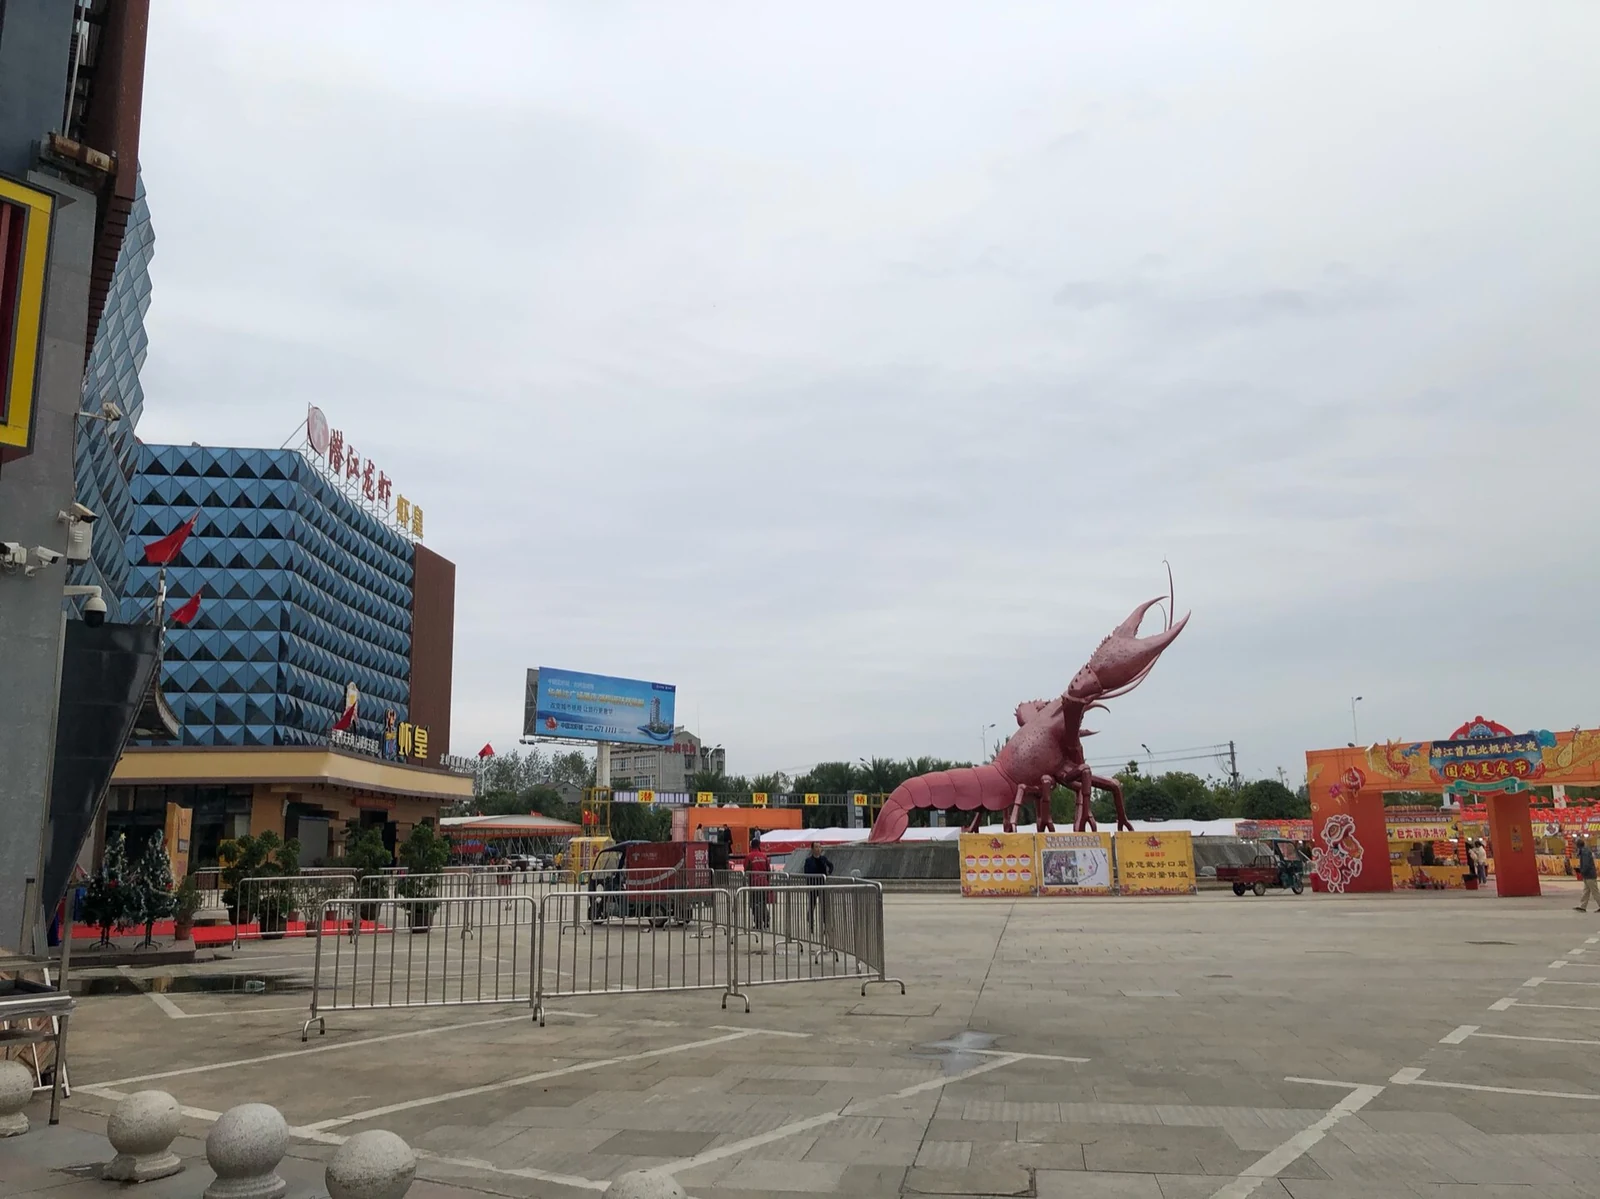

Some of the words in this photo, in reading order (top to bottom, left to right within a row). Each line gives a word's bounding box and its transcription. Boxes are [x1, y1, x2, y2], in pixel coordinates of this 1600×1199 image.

[398, 721, 429, 759] 虾皇
[1431, 740, 1538, 758] 潜江首届北极光之夜
[1445, 761, 1527, 778] 国潮美食节
[1125, 860, 1188, 868] 请您戴好口罩
[1126, 871, 1189, 879] 配合测量体温
